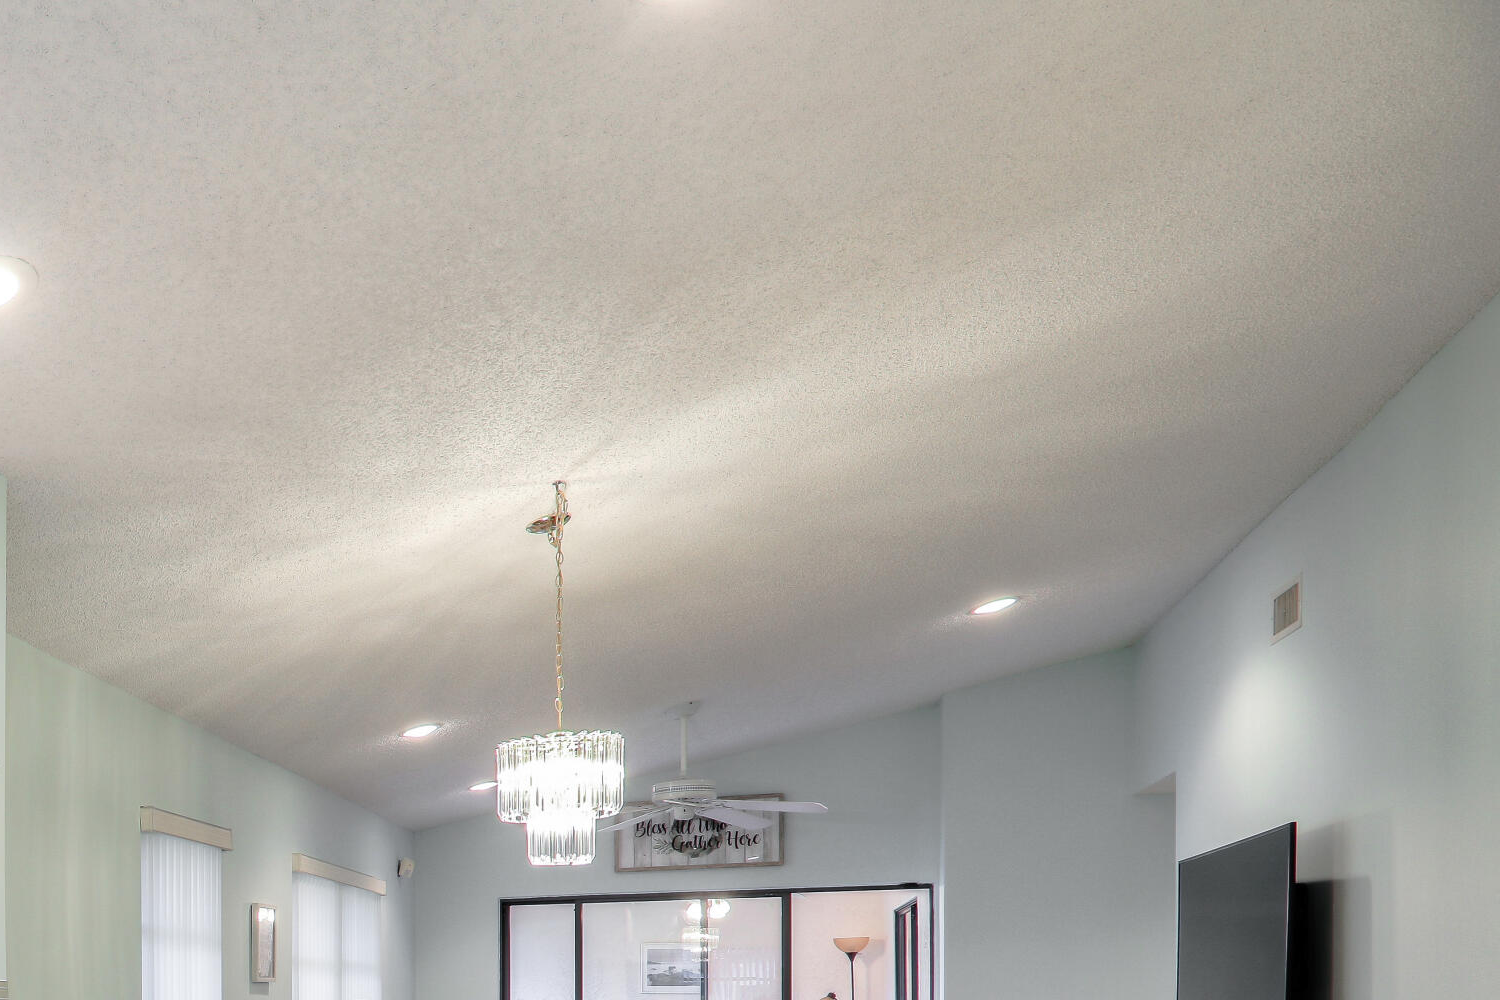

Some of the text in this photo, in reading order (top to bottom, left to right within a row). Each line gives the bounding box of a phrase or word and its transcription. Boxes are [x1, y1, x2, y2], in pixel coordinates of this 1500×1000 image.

[635, 819, 667, 838] Bless
[672, 819, 695, 835] All
[671, 831, 761, 852] Gather Here
